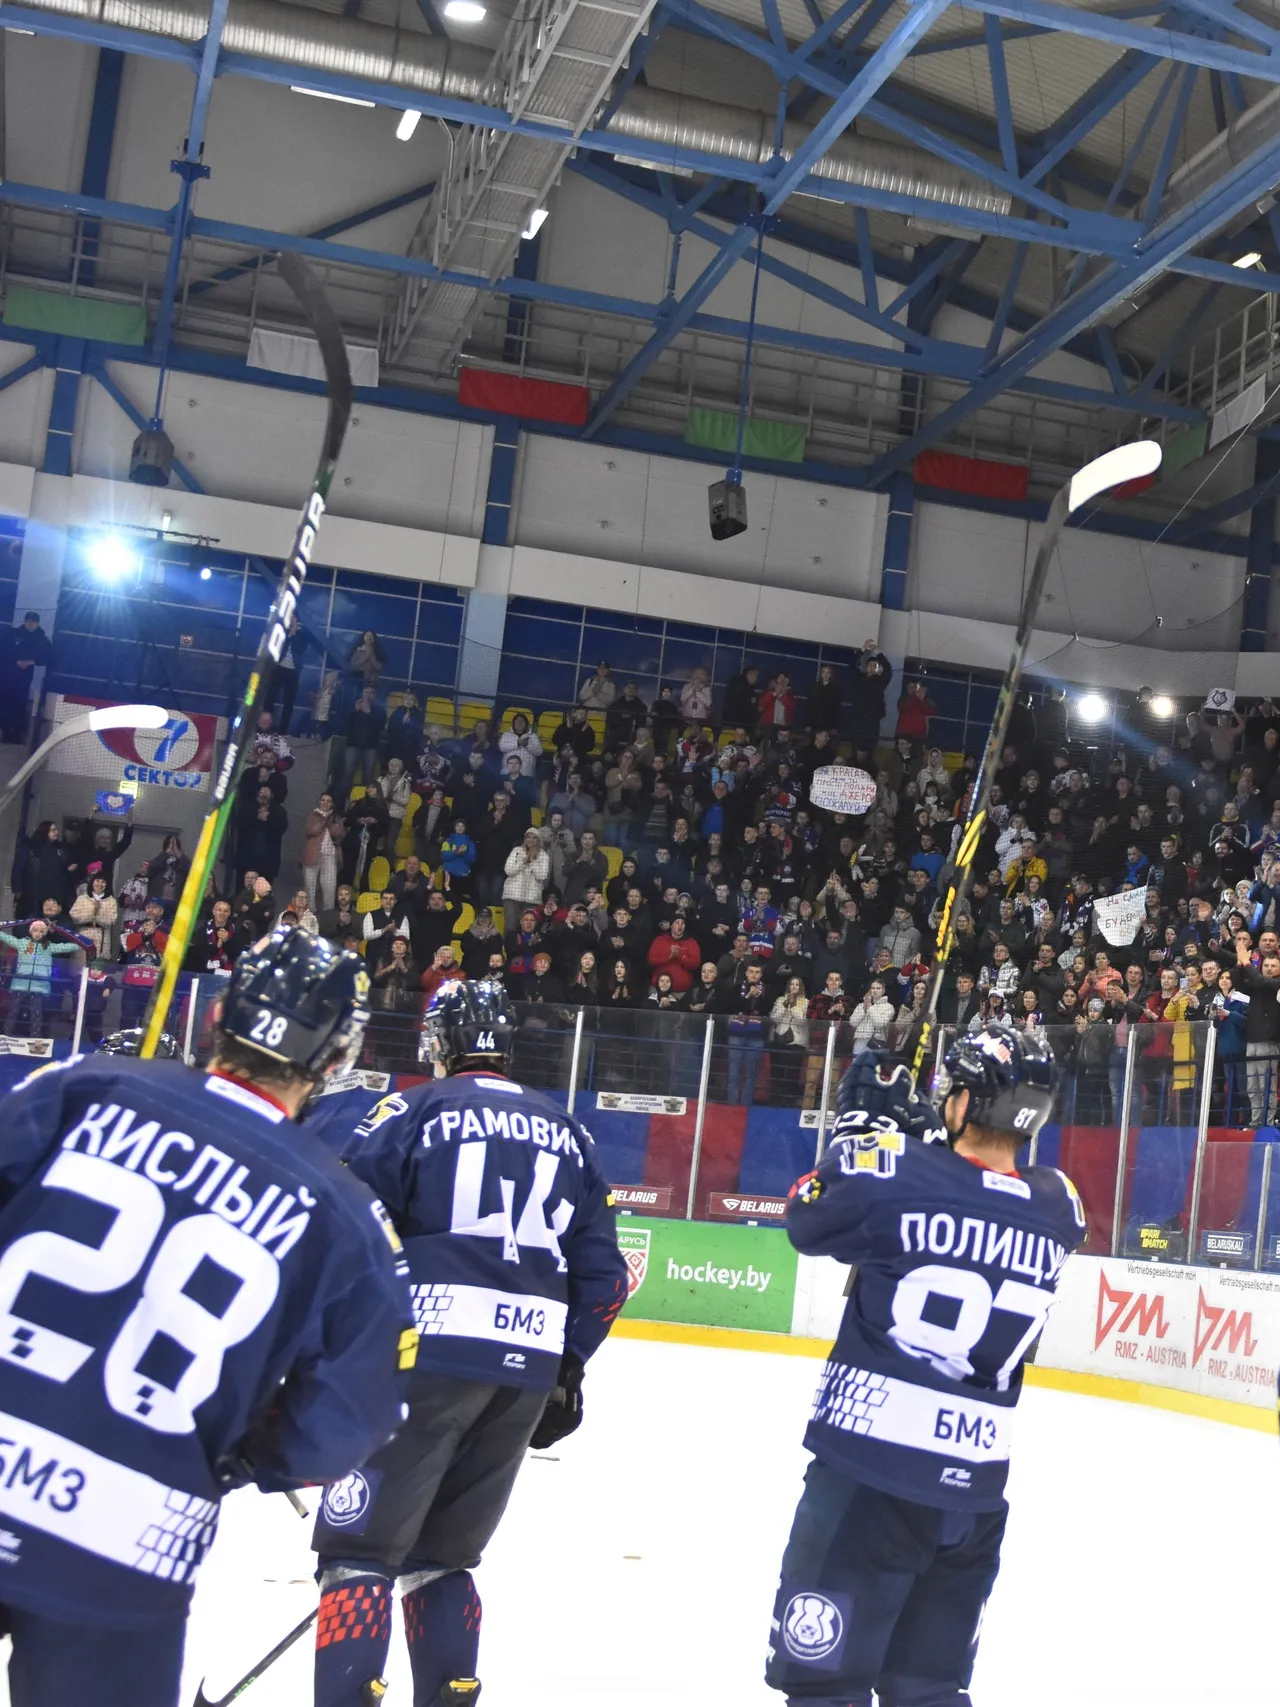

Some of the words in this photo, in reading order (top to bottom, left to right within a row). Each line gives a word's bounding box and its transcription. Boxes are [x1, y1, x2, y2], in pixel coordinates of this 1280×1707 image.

[154, 719, 189, 762] 7
[124, 764, 201, 788] СЕКТОР
[250, 1007, 287, 1046] 28
[476, 1031, 495, 1049] 44
[1013, 1107, 1037, 1129] 87
[62, 1103, 317, 1261] КИСЛЫЙ
[611, 1189, 658, 1204] BELARUS
[450, 1140, 576, 1272] 44
[739, 1200, 786, 1214] BELARUS
[618, 1235, 646, 1246] АРУСЬ
[901, 1212, 1069, 1286] ПОЛИЩУ
[667, 1258, 773, 1292] hockey.by
[1127, 1264, 1184, 1280] Vertriebsgesellschaft
[1185, 1271, 1197, 1281] mbH
[1220, 1275, 1273, 1291] Vertriebsgesellschaft
[0, 1149, 281, 1435] 28
[493, 1303, 546, 1337] БМЗ
[889, 1262, 1055, 1393] 87
[1115, 1341, 1138, 1360] RMZ
[1146, 1346, 1187, 1368] AUSTRIA
[1208, 1359, 1228, 1378] RMZ
[1234, 1364, 1276, 1387] AUSTRIA
[933, 1408, 998, 1451] БМЗ
